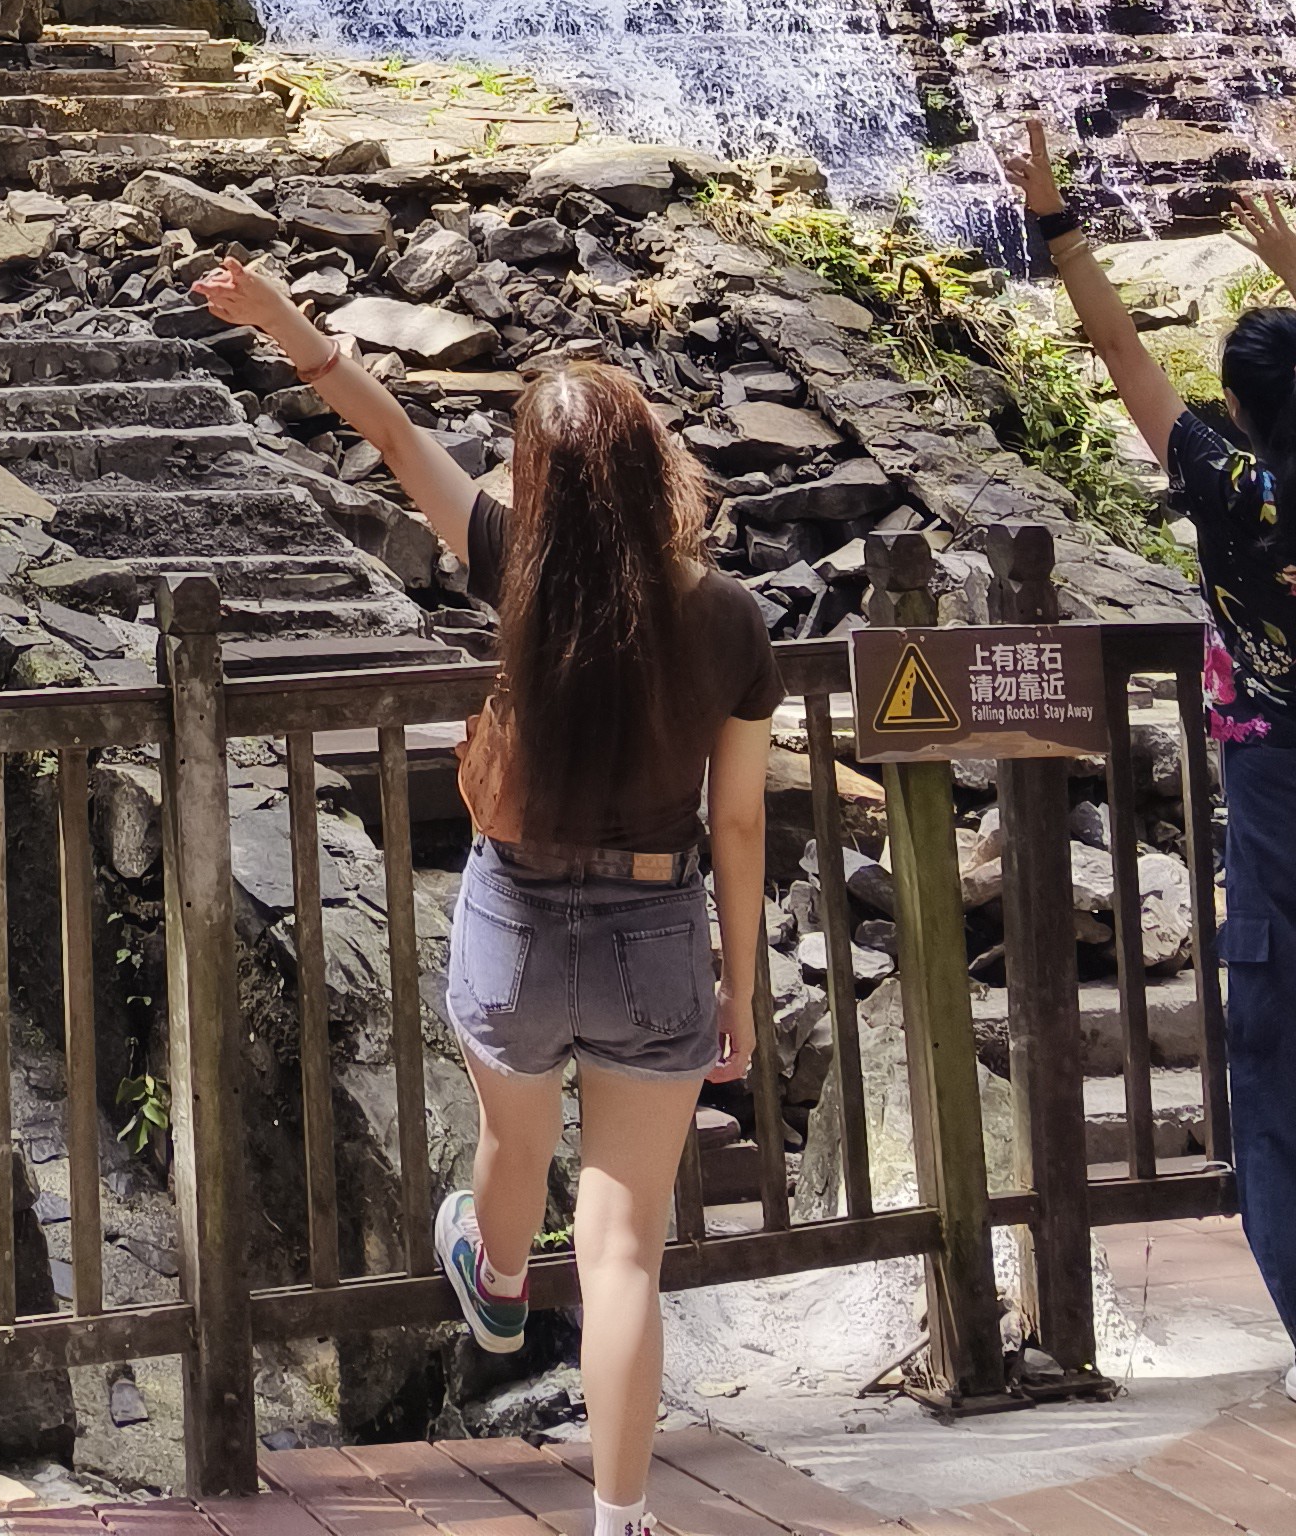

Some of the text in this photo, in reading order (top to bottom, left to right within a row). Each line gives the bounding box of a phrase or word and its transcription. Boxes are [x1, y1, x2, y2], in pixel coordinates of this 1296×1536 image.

[968, 642, 1063, 671] 上有落石
[969, 672, 1066, 702] 请勿靠近
[971, 703, 1094, 725] Falling Rocks! Stay Away
